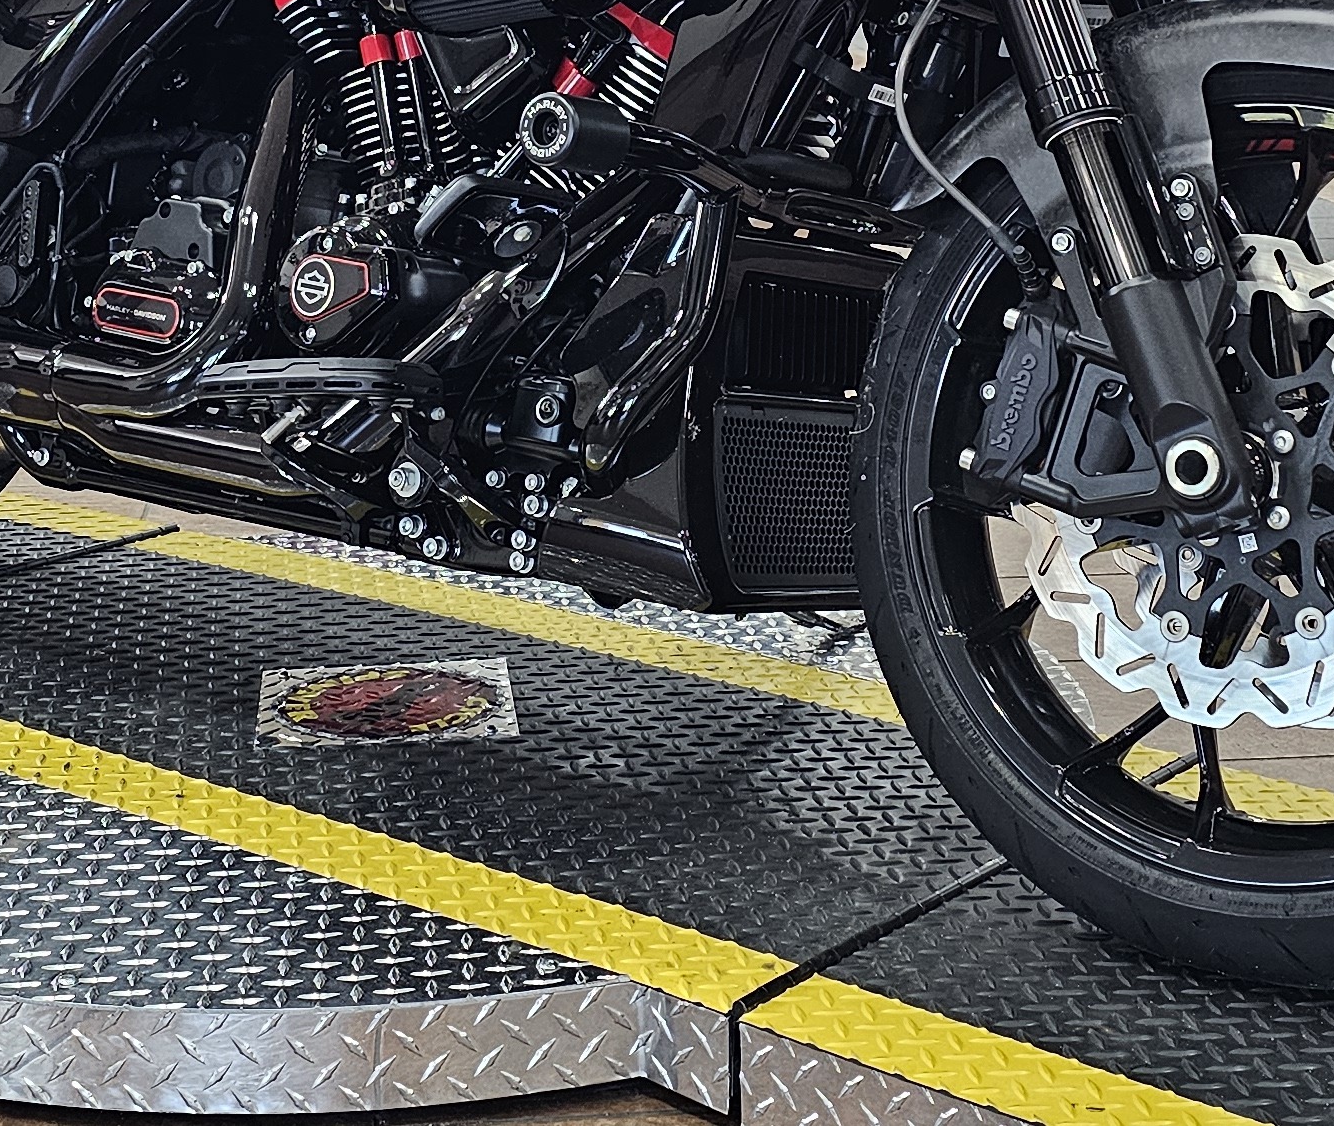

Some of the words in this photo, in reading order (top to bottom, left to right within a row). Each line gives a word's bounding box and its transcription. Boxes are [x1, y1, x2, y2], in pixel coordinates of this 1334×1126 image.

[527, 99, 568, 120] HARLEY
[522, 130, 567, 158] DAVIDSON
[990, 353, 1037, 451] brembo
